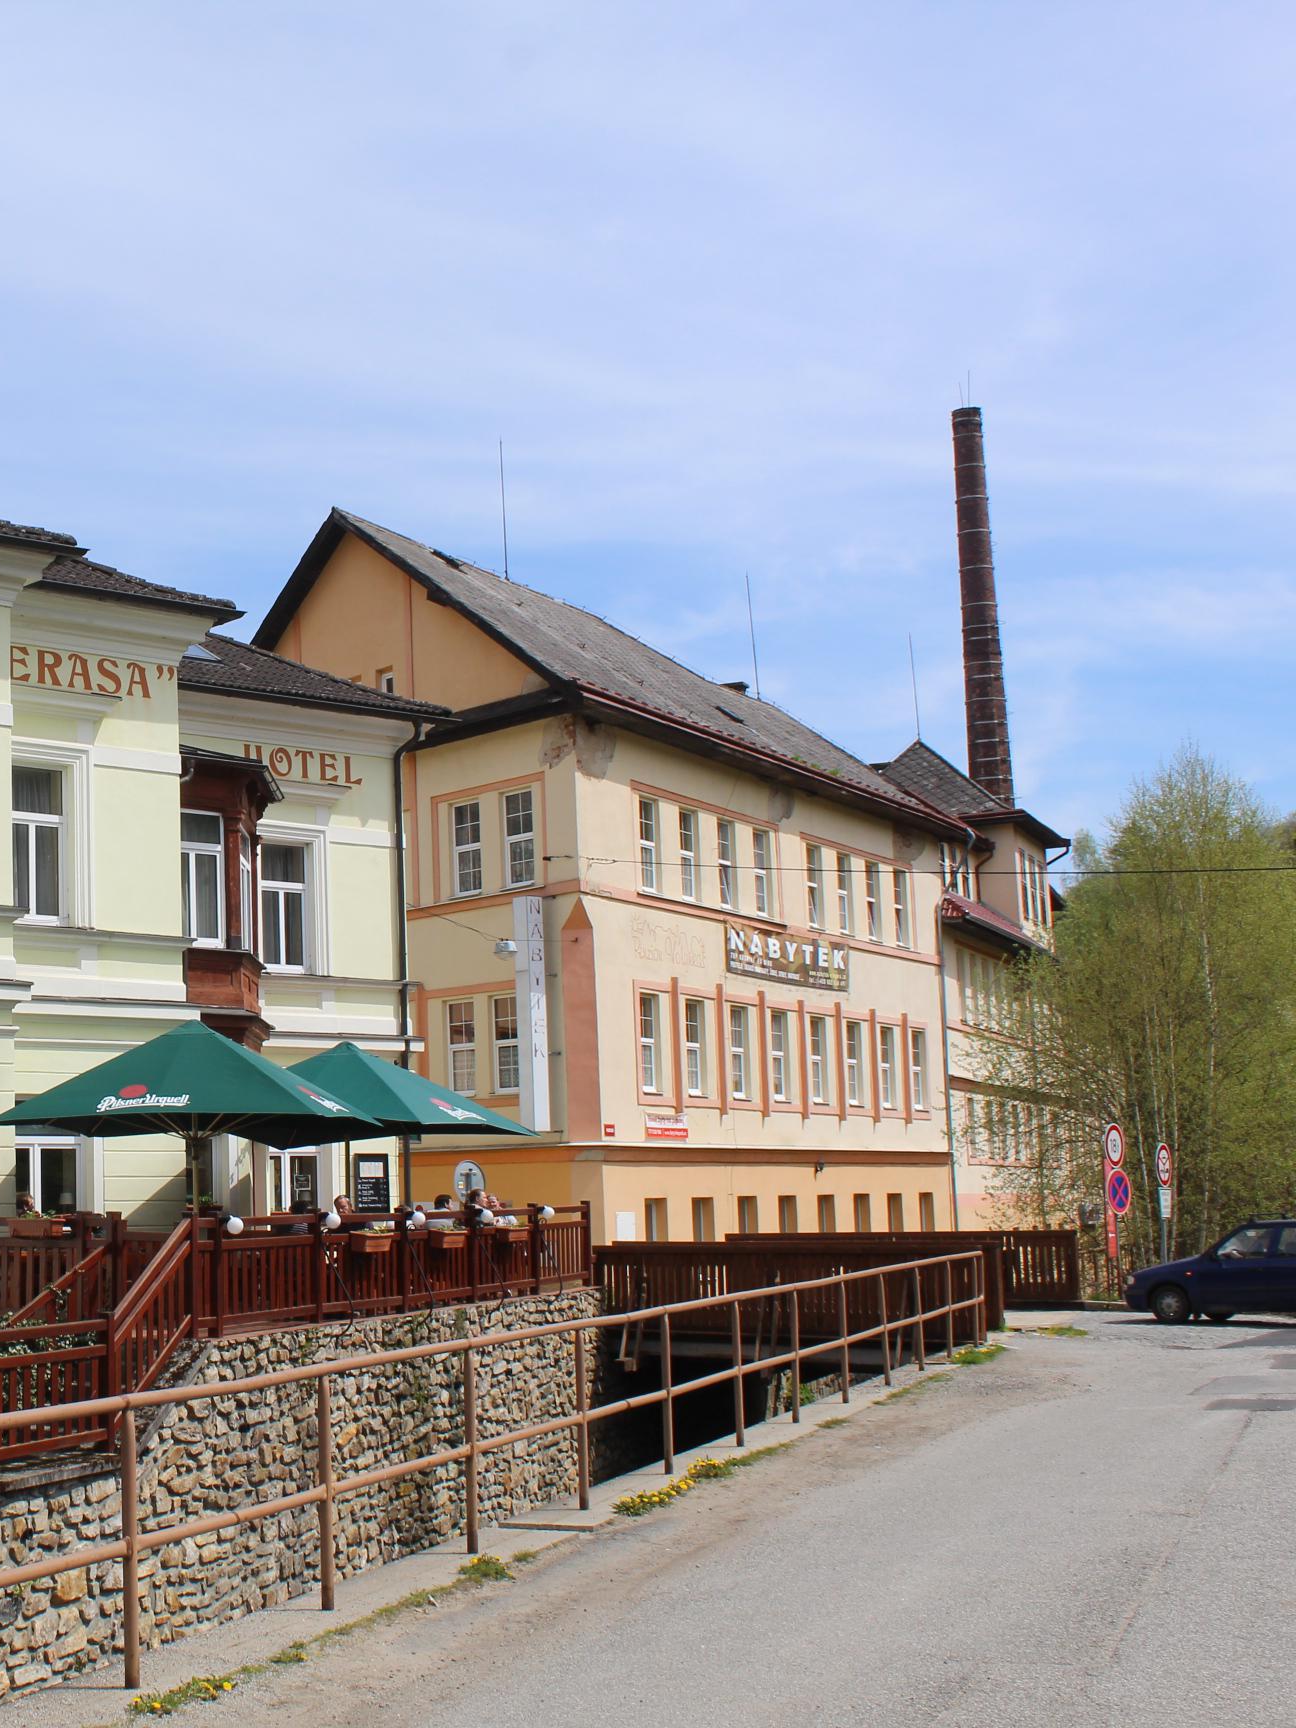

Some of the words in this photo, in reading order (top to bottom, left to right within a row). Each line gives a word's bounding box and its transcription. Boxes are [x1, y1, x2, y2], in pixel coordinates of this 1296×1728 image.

[728, 928, 846, 970] NÁBYTEK
[96, 1095, 146, 1112] Pilsner
[144, 1093, 190, 1107] Urquell
